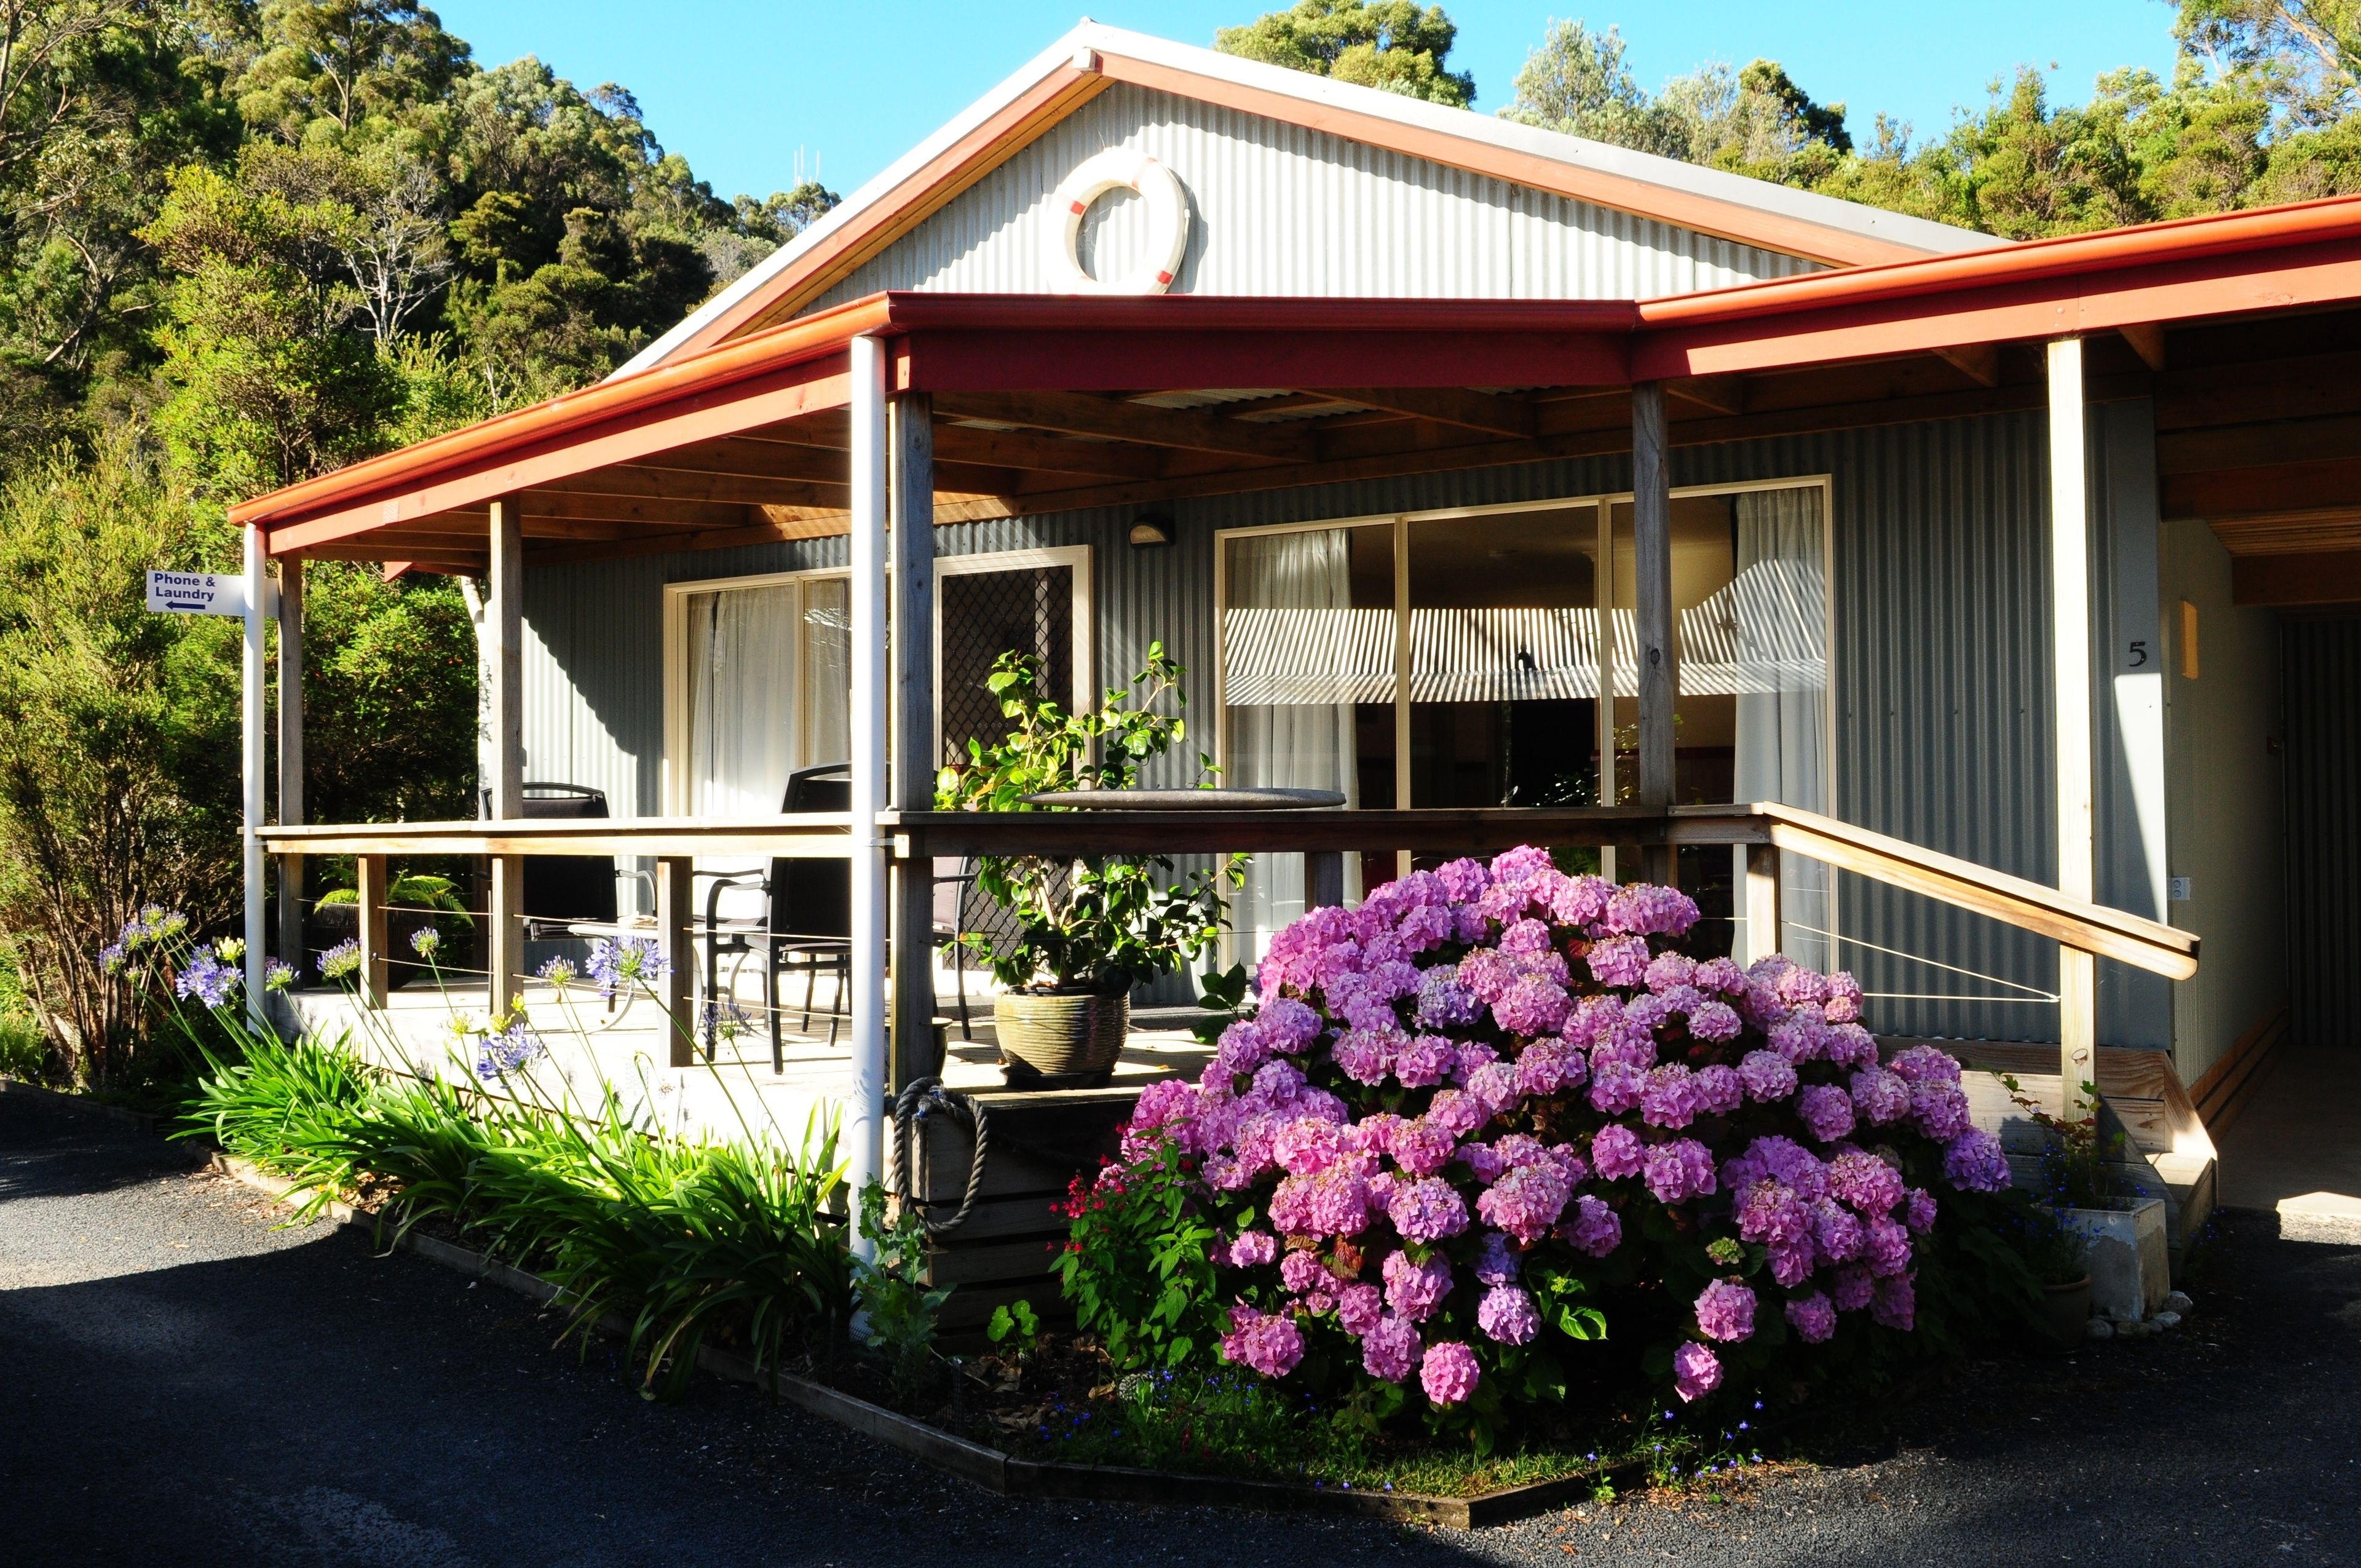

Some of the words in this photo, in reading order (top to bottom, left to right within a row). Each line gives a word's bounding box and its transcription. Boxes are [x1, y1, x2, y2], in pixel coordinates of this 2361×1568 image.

[154, 573, 200, 585] Phone
[205, 577, 215, 587] &
[156, 587, 214, 601] Laundry
[2129, 641, 2146, 667] 5
